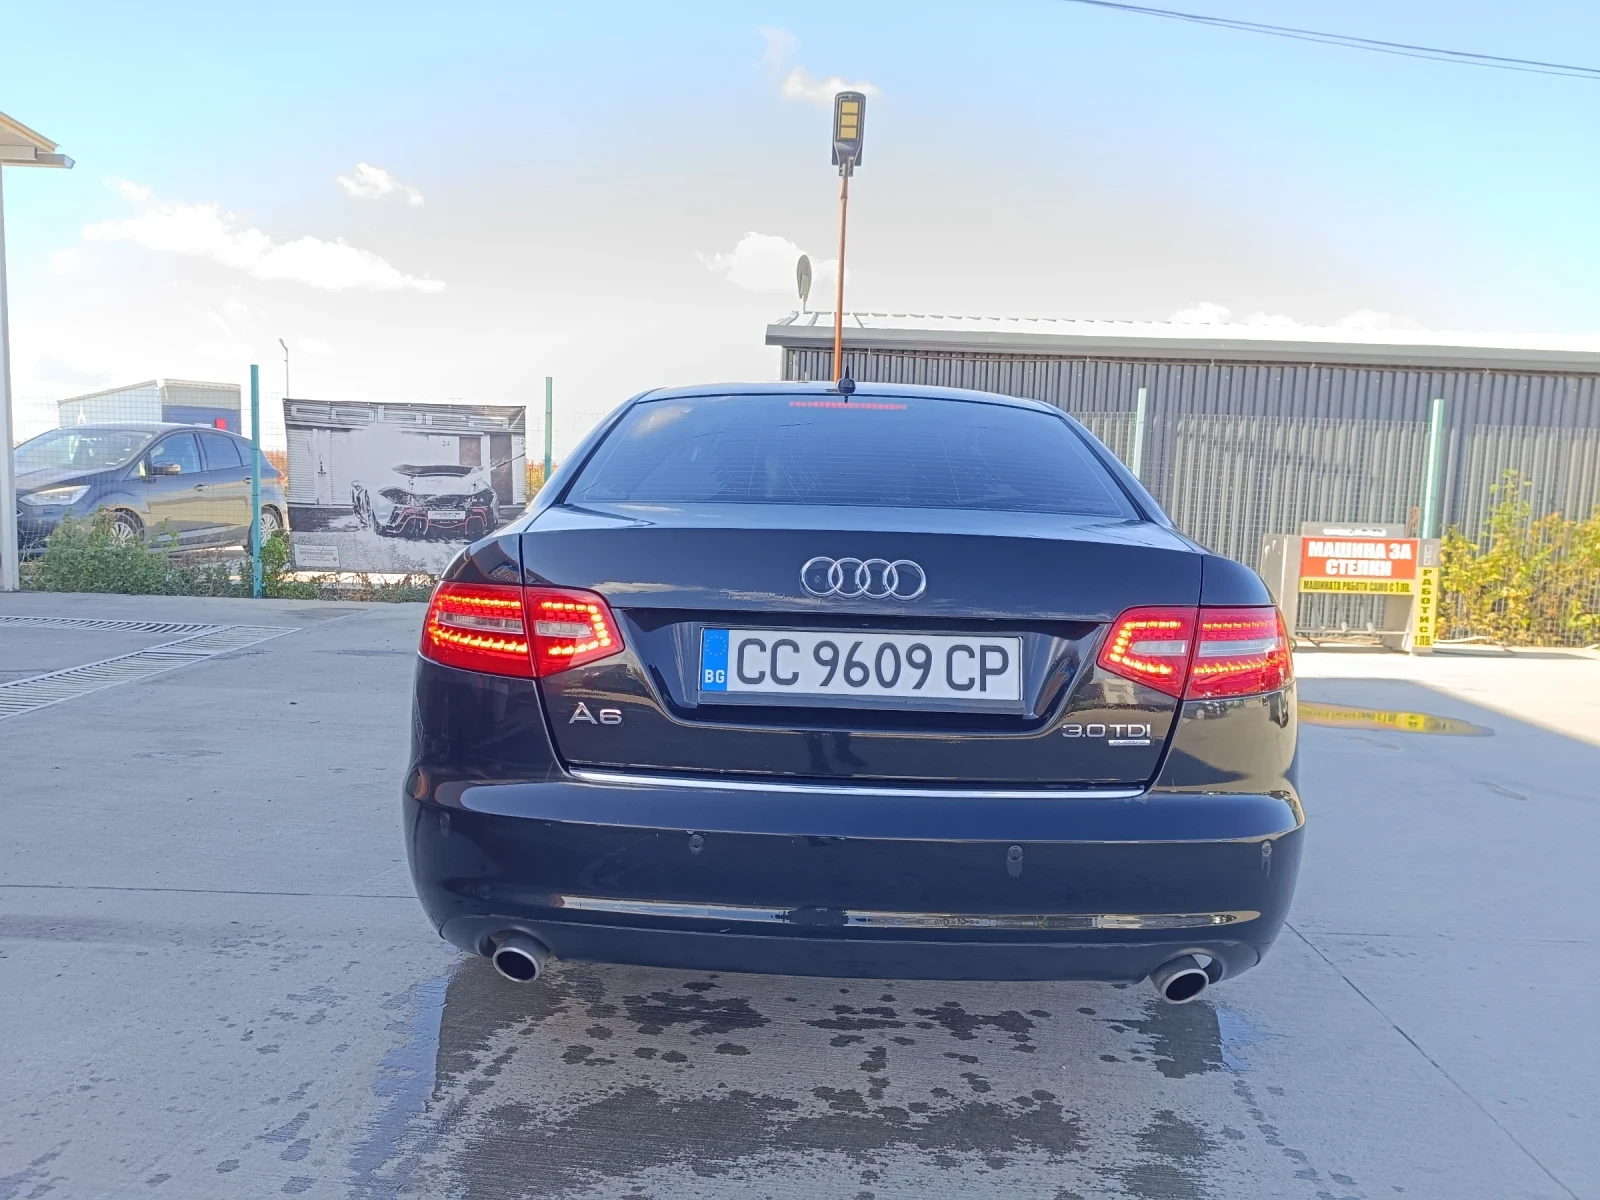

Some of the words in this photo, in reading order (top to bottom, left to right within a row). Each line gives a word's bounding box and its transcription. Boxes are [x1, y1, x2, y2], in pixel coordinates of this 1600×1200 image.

[1308, 541, 1387, 559] МАШИНА
[1389, 543, 1412, 560] ЗА
[1325, 559, 1393, 576] СТЕЛКИ
[1303, 580, 1341, 591] МАШИНАТА
[1342, 581, 1368, 591] РАБОТИ
[1369, 582, 1388, 592] САМО
[736, 638, 800, 686] CC
[813, 640, 933, 690] 9609
[946, 644, 1010, 692] CP
[704, 669, 726, 684] BG
[568, 701, 623, 725] A6
[1061, 723, 1106, 738] 3.0
[1108, 723, 1151, 738] TDI
